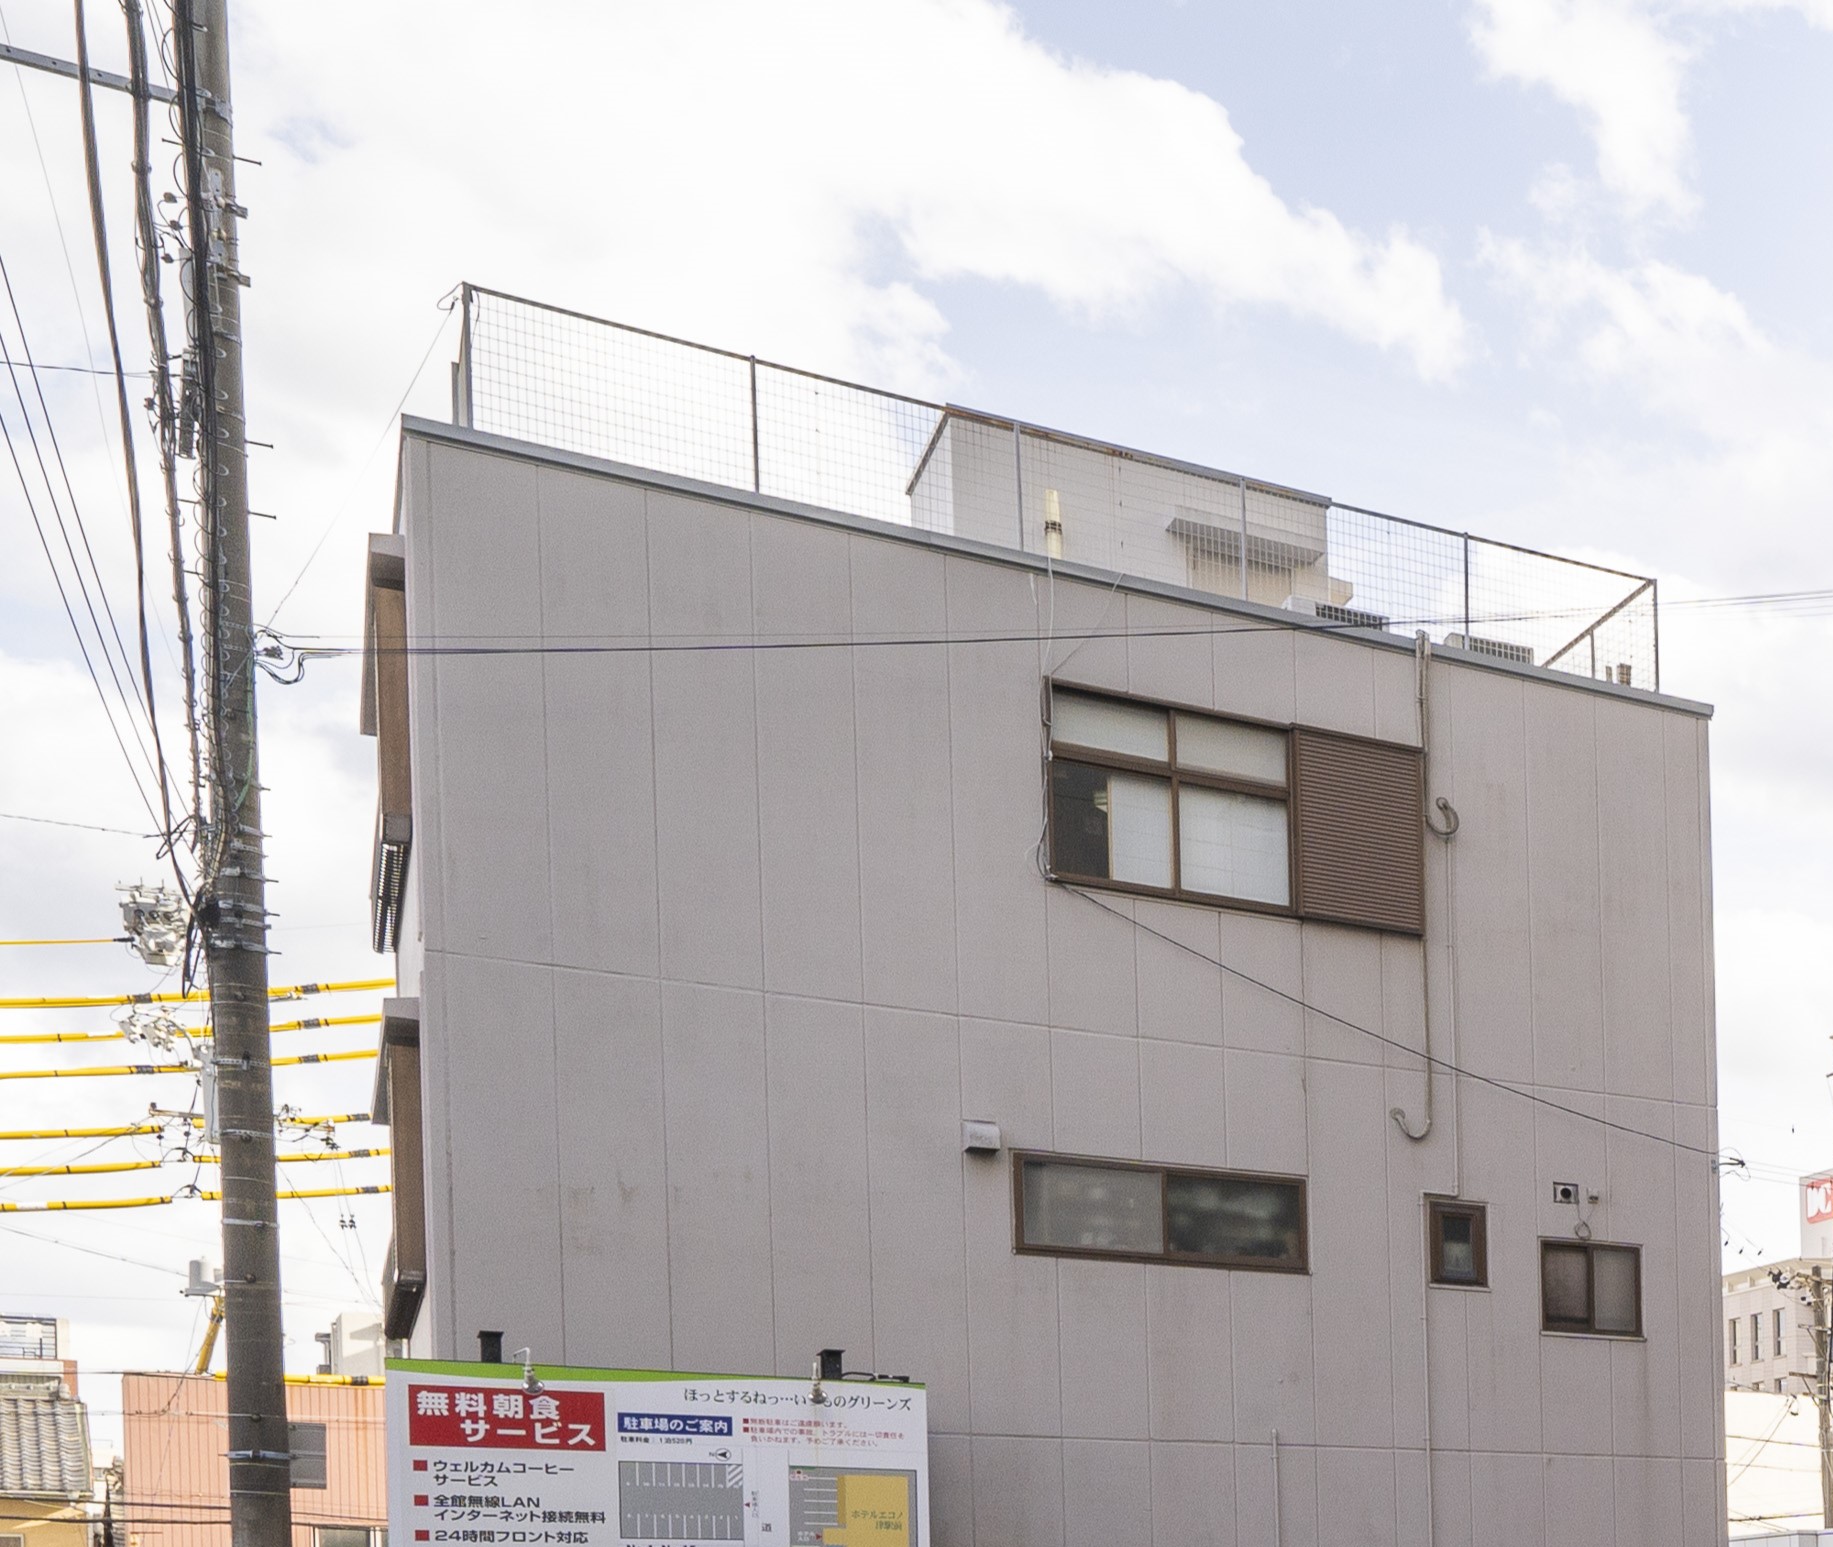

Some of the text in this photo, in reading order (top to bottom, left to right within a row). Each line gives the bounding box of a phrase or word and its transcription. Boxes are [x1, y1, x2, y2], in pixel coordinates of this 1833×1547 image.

[416, 1391, 560, 1421] 無料朝食
[623, 1416, 728, 1434] 駐車場のご案内
[460, 1419, 596, 1447] サービス
[433, 1460, 575, 1475] ウェルカムコーヒー
[433, 1474, 499, 1487] サービス
[434, 1495, 540, 1509] 全館無線LAN
[434, 1509, 606, 1525] インターネット接続無料
[435, 1530, 589, 1544] 24時間フロント対応
